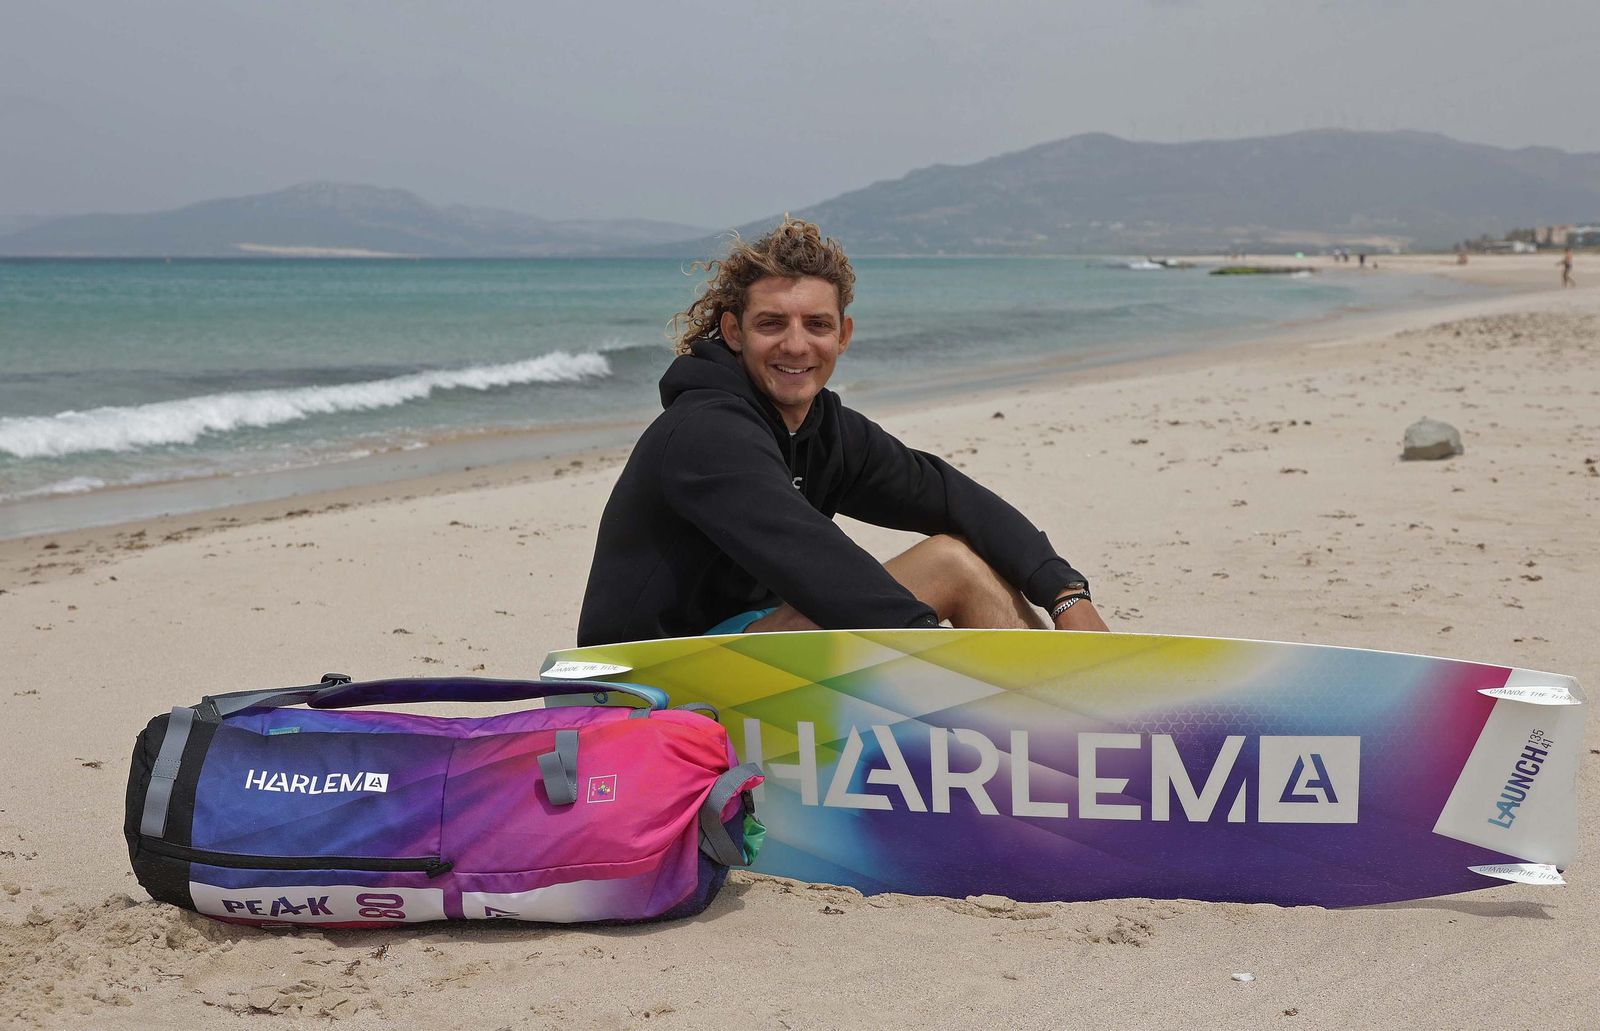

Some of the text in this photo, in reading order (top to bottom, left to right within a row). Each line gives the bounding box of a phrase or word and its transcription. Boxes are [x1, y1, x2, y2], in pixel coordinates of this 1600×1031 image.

[1541, 738, 1553, 749] 41
[245, 769, 364, 794] HARLEM
[743, 718, 1246, 823] HARLEM
[1488, 728, 1548, 829] LAUNCH 135
[222, 893, 406, 919] PEAK 80
